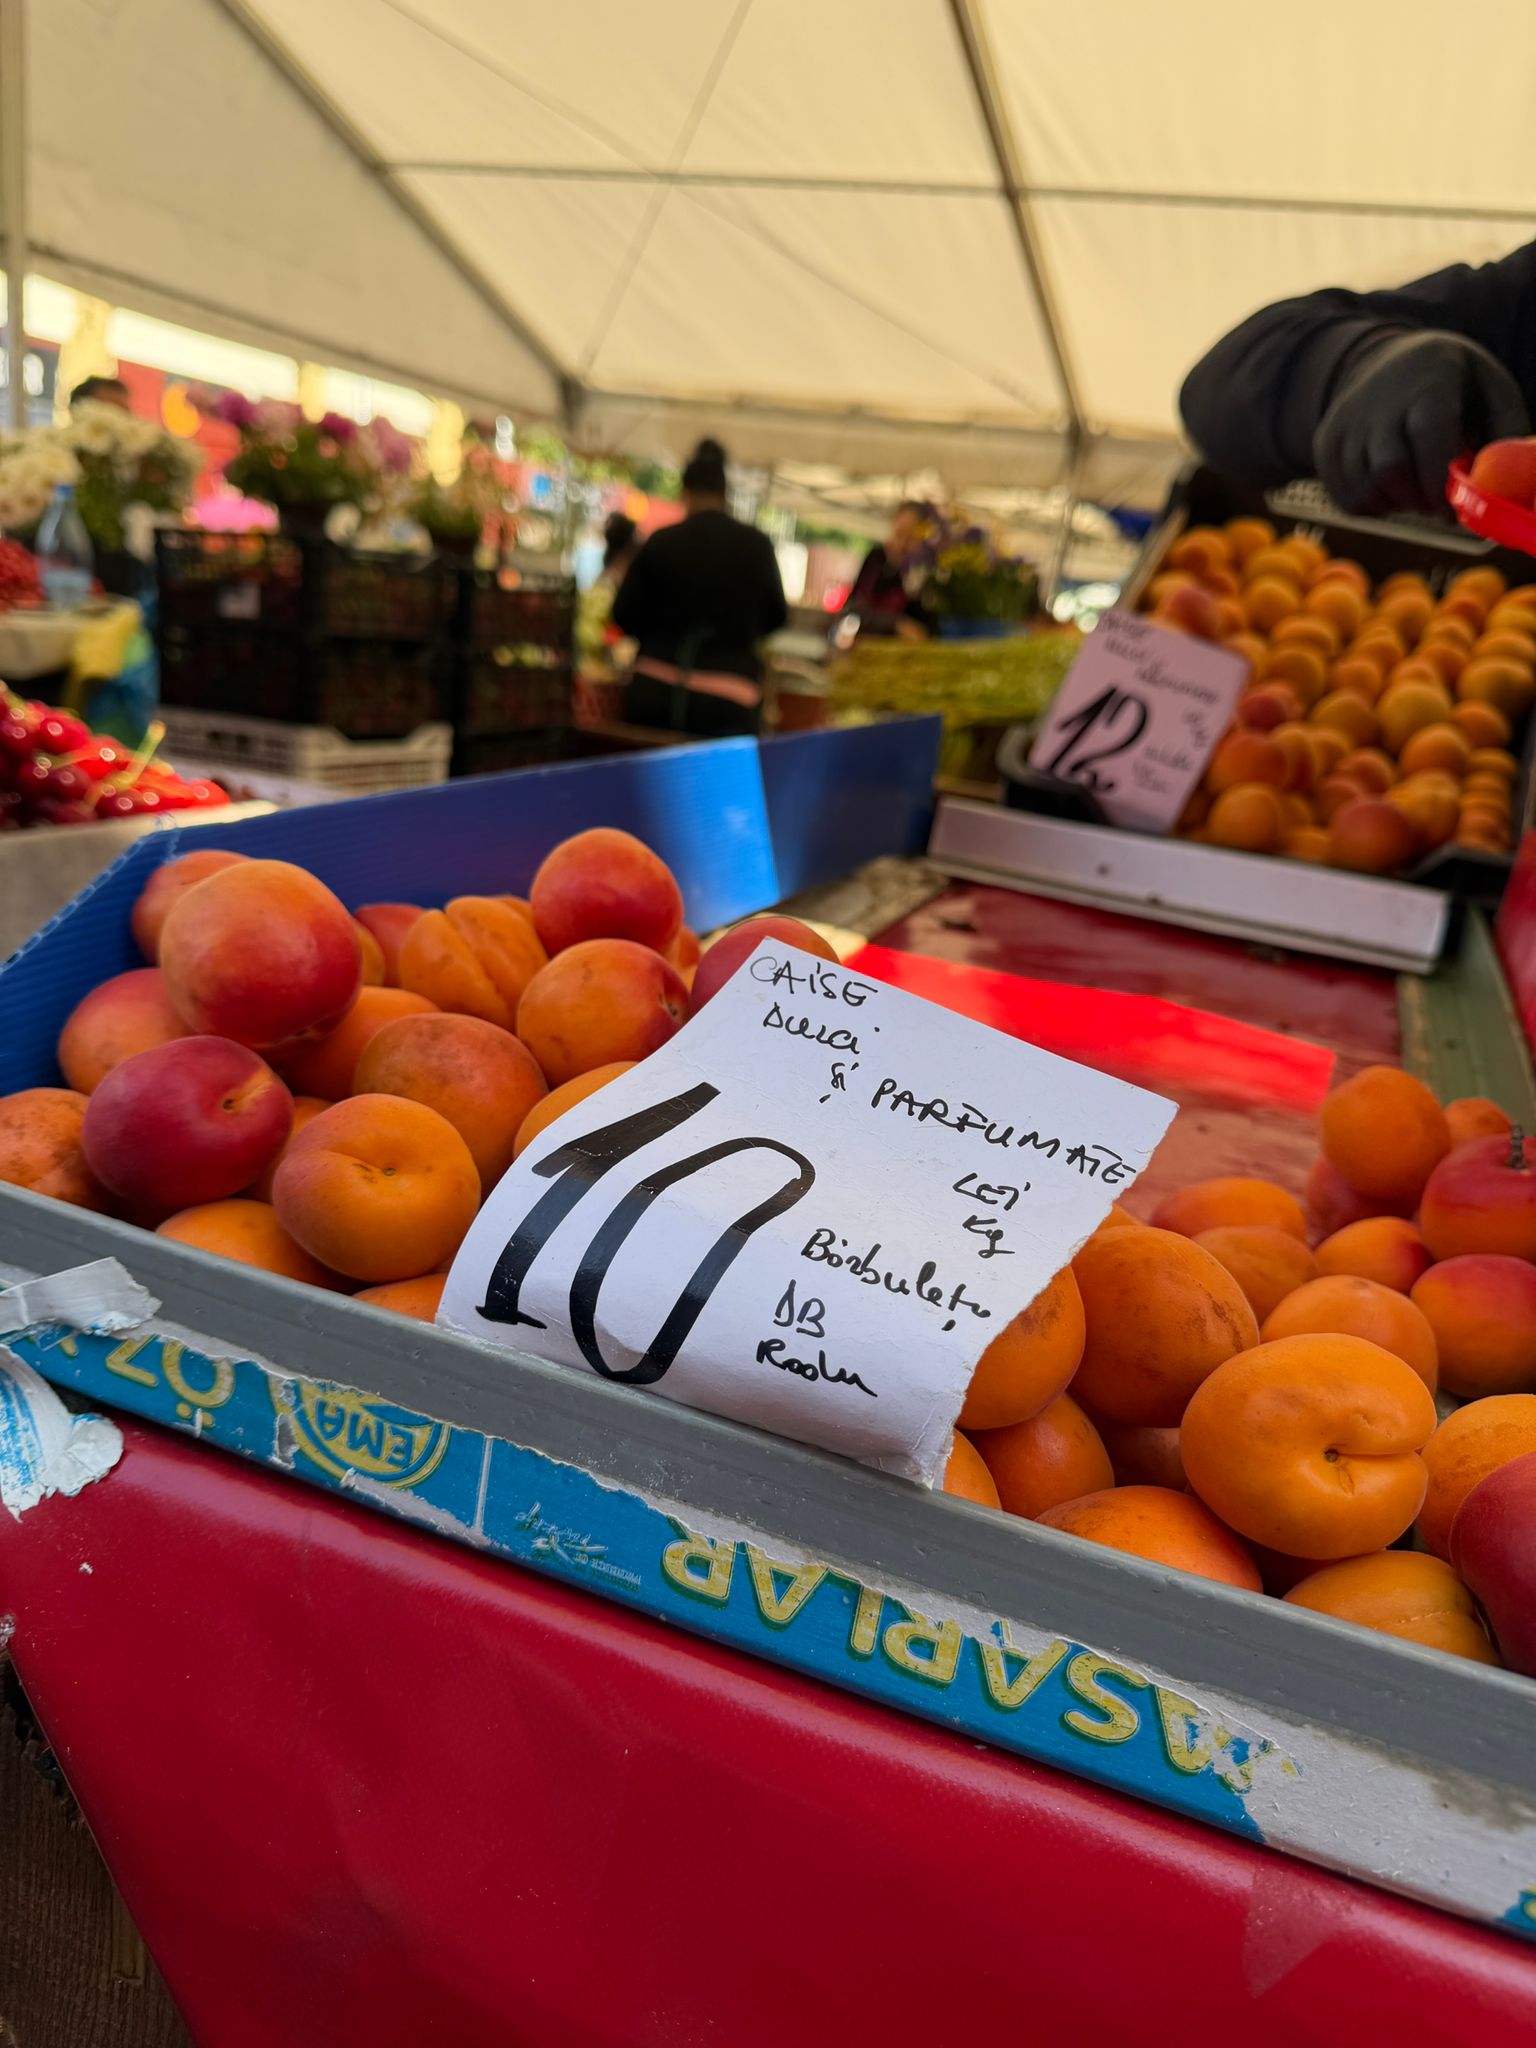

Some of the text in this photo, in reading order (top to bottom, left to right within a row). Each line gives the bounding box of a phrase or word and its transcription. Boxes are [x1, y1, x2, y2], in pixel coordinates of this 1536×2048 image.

[1049, 686, 1148, 793] 12
[474, 1081, 816, 1385] 10
[313, 1398, 421, 1468] EMA
